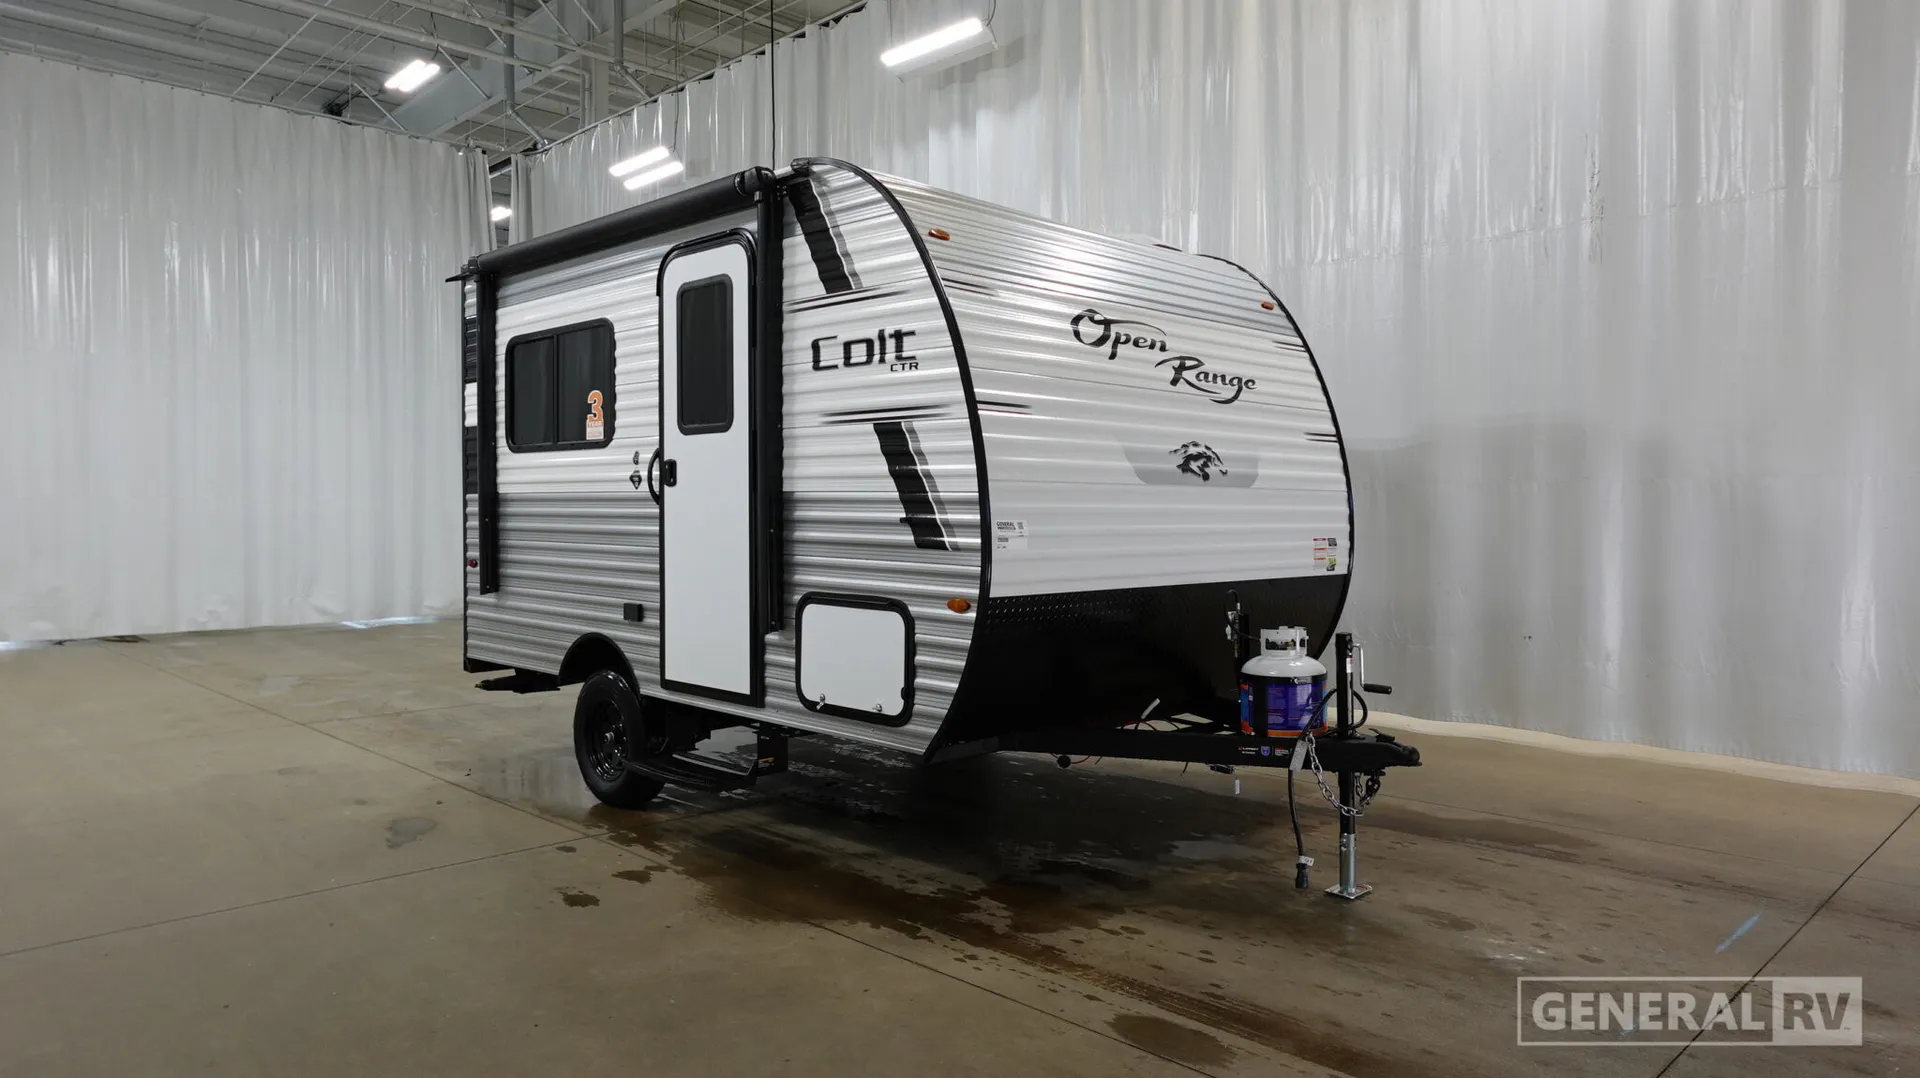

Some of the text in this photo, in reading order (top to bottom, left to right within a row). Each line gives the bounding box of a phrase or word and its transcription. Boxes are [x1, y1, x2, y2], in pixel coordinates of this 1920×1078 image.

[811, 328, 917, 371] Colt
[1070, 308, 1169, 360] Open
[890, 362, 919, 372] CTR
[1155, 355, 1258, 404] Range
[587, 390, 603, 422] 3
